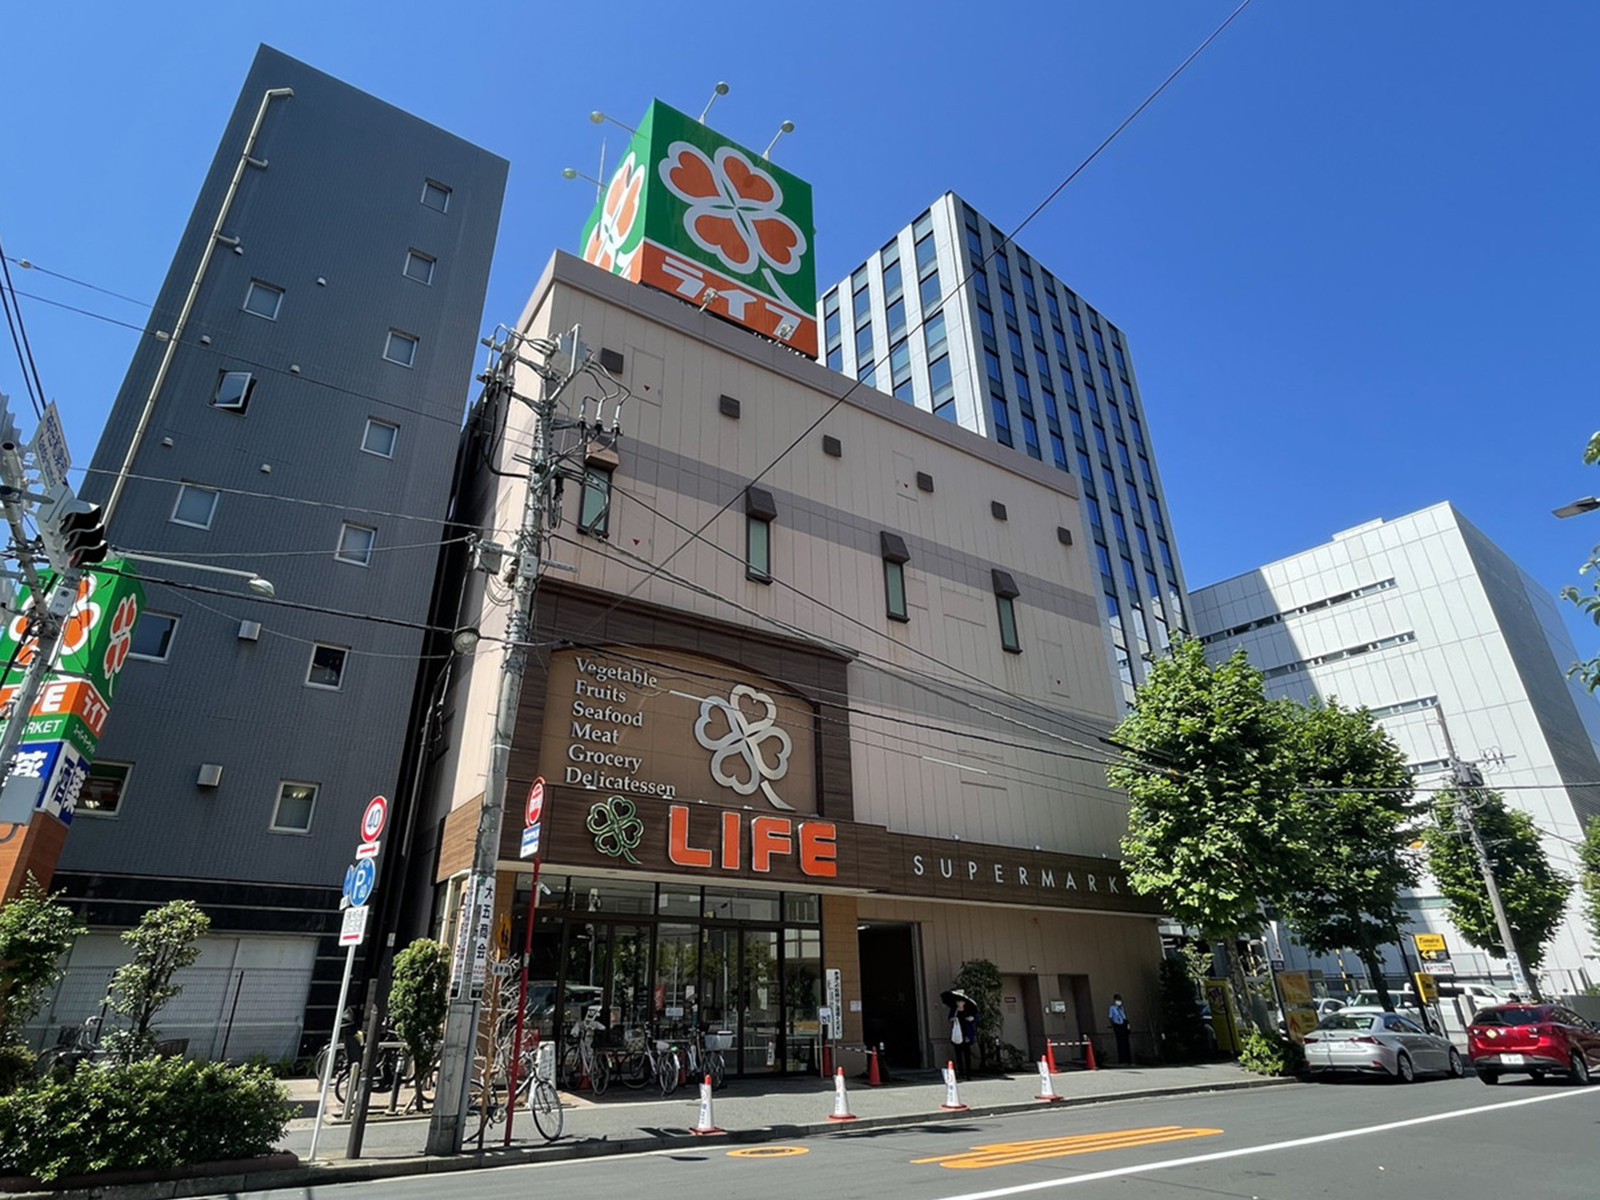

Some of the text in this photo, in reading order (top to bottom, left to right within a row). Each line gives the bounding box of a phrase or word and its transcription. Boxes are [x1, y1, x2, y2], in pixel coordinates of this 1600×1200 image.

[661, 255, 802, 342] ライフ
[575, 656, 658, 687] Vegetable
[575, 679, 627, 703] Fruits
[82, 689, 107, 732] ライフ
[572, 700, 643, 728] Seafood
[571, 721, 619, 744] Meat
[568, 743, 643, 774] Grocery
[565, 766, 676, 797] Delicatessen
[366, 808, 381, 830] 40
[668, 804, 838, 877] LIFE
[352, 869, 367, 900] P
[912, 854, 1140, 896] SUPERMARK
